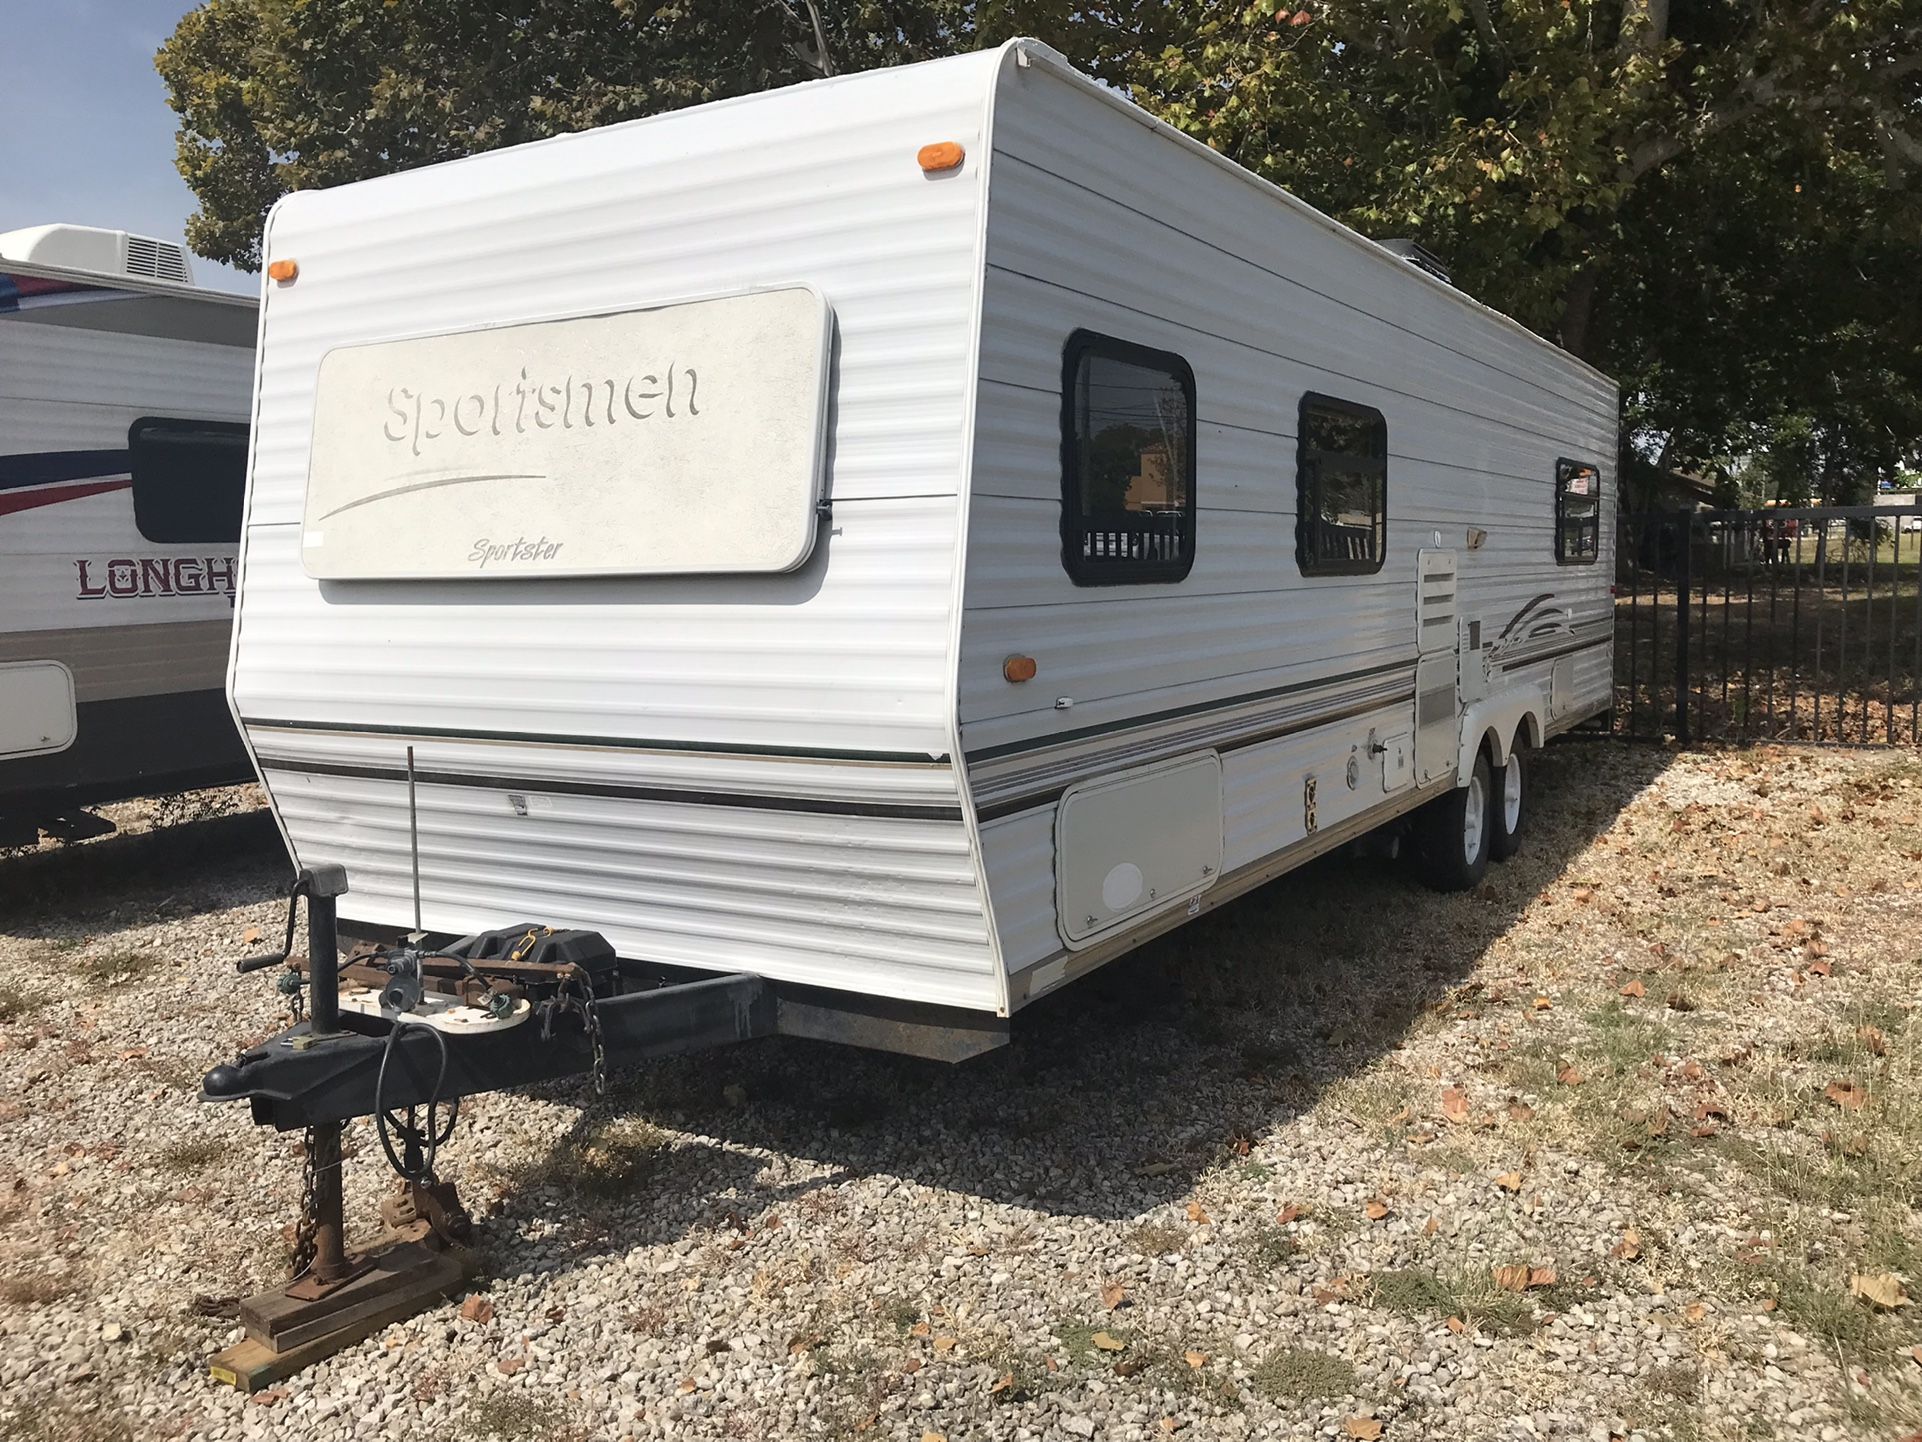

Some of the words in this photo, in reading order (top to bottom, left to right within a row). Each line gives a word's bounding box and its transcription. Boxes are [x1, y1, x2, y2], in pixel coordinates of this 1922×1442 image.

[384, 361, 700, 456] Sportsmen
[467, 536, 564, 569] Sportster
[75, 557, 239, 599] LONGH
